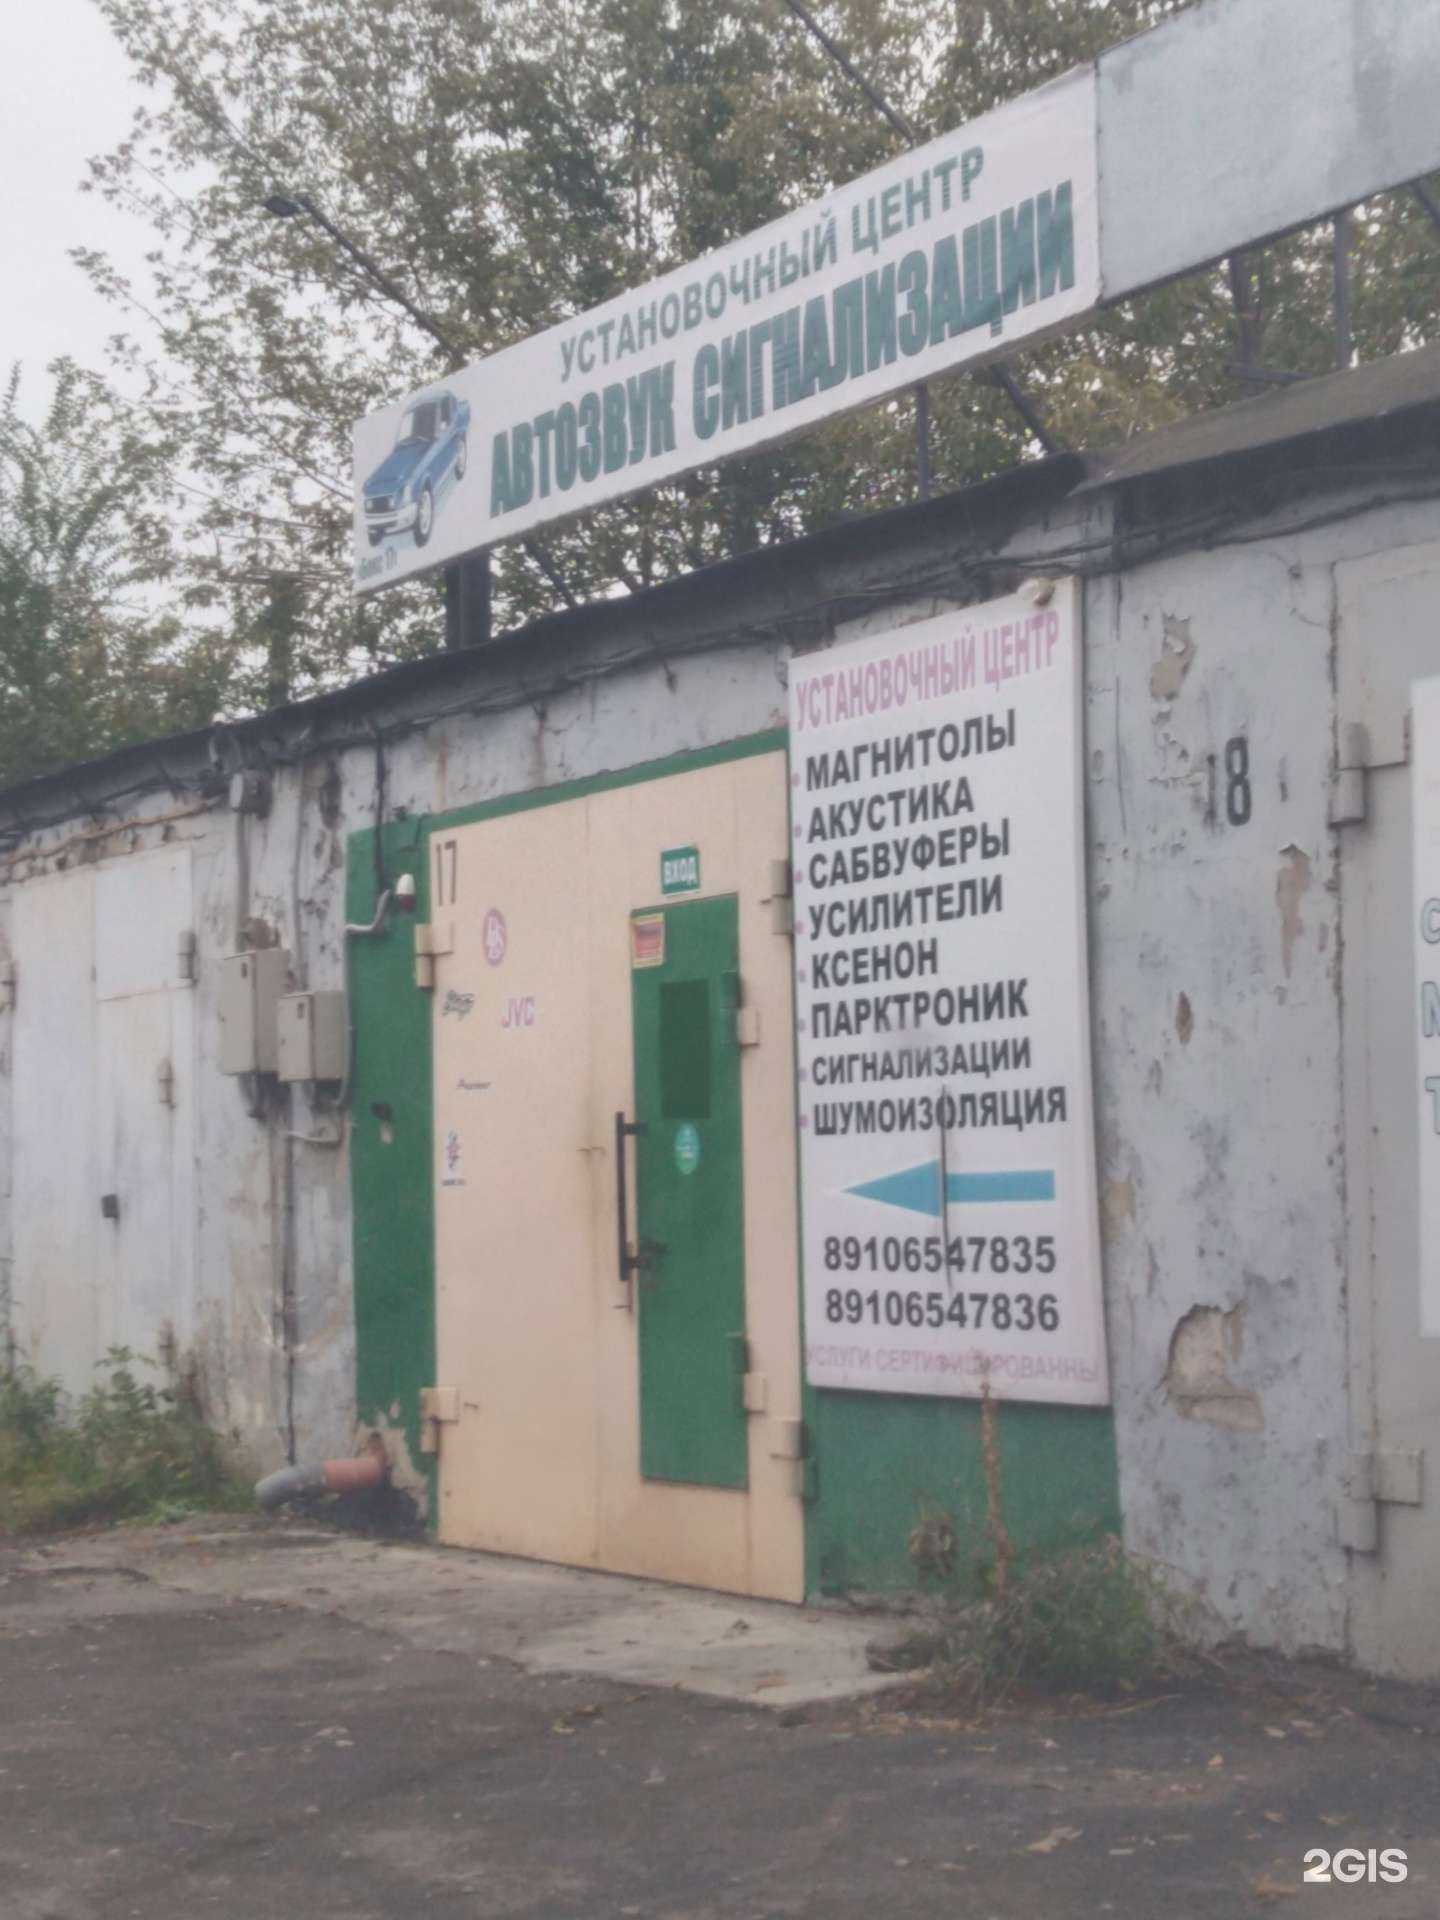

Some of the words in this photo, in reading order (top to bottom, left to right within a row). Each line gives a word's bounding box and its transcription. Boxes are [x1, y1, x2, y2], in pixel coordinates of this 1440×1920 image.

[560, 207, 838, 383] УСТАНОВОЧНЫЙ
[850, 145, 985, 256] ЦЕНТР
[489, 360, 677, 519] АВТОЗВУК
[692, 179, 1076, 441] СИГНАЛИЗАЦИИ
[796, 622, 976, 731] УСТАНОВОЧНЫЙ
[983, 609, 1060, 690] ЦЕНТР
[805, 708, 1017, 792] МАГНИТОЛЫ
[1203, 736, 1252, 828] 18
[806, 776, 975, 843] АКУСТИКА
[435, 840, 457, 908] 17
[663, 856, 698, 886] ВХОД
[808, 817, 1010, 890] САБВУФЕРЫ
[808, 874, 1004, 941] УСИЛИТЕЛИ
[811, 937, 939, 990] КСЕНОН
[501, 996, 535, 1029] JVC
[811, 978, 1030, 1039] ПАРКТРОНИК
[811, 1036, 1032, 1087] СИГНАЛИЗАЦИИ
[813, 1085, 1068, 1137] ШУМОИЗОЛЯЦИЯ
[823, 1234, 1057, 1274] 89106547835
[825, 1287, 1060, 1332] 89106547836
